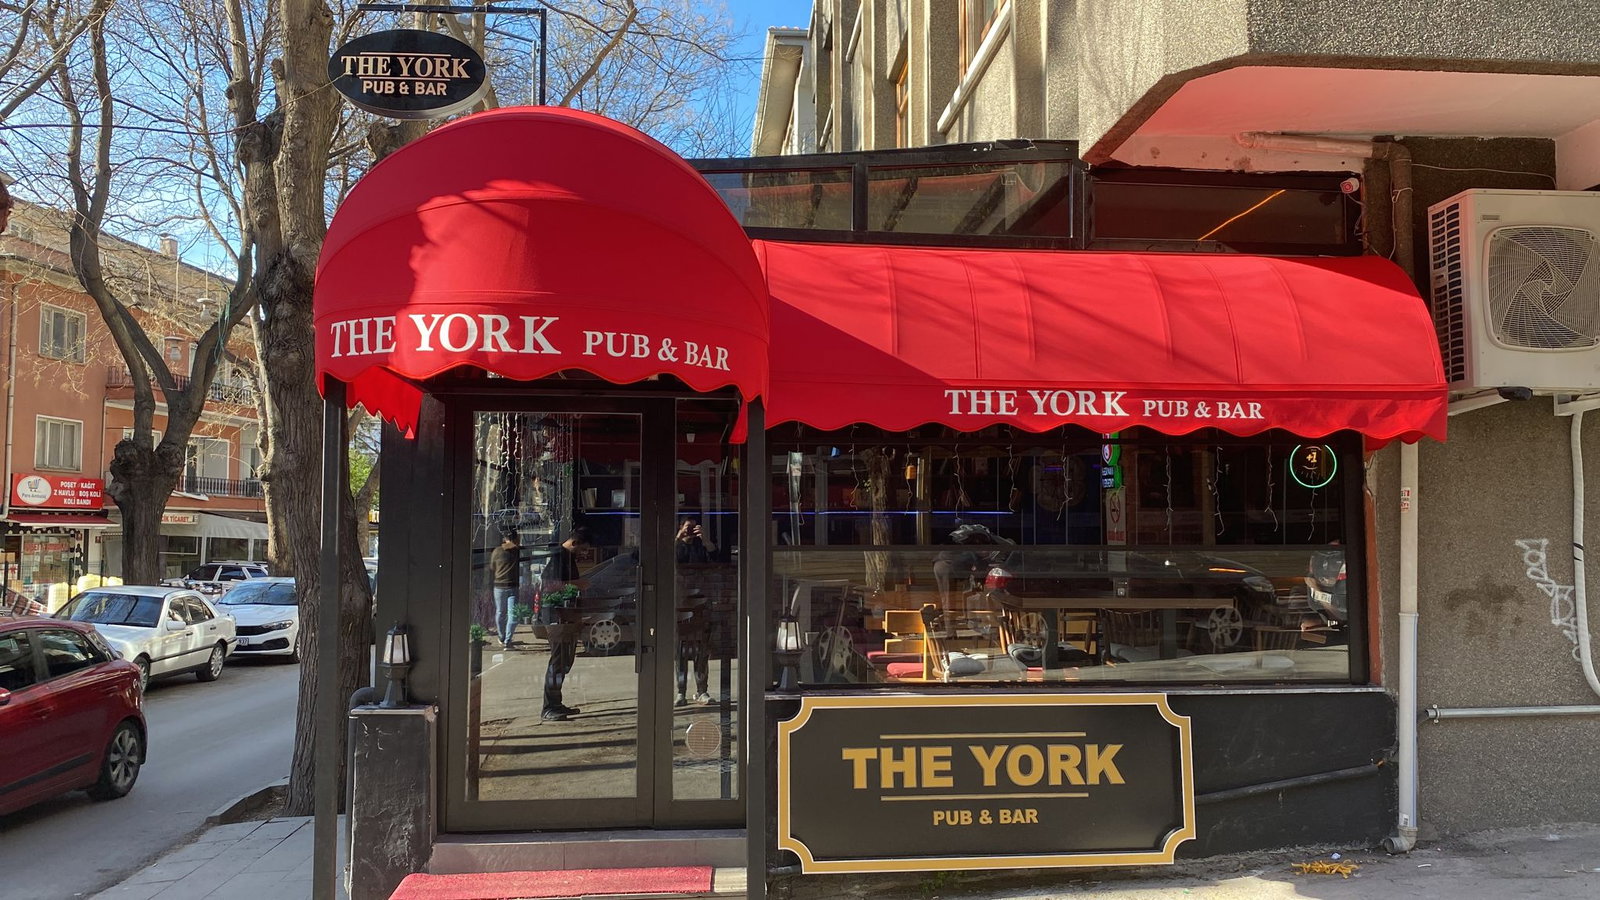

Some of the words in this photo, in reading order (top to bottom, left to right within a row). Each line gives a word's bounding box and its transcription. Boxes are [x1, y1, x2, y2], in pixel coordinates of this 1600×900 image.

[341, 55, 391, 76] THE
[397, 56, 471, 78] YORK
[362, 80, 395, 94] PUB
[399, 81, 410, 95] &
[415, 82, 447, 96] BAR
[331, 315, 396, 358] THE
[409, 313, 561, 356] YORK
[583, 330, 650, 358] PUB
[657, 338, 679, 362] &
[685, 341, 731, 371] BAR
[944, 389, 1018, 416] THE
[1026, 389, 1129, 417] YORK
[1142, 399, 1189, 418] PUB
[1194, 401, 1211, 418] &
[1216, 401, 1265, 419] BAR
[842, 746, 954, 789] THE
[969, 744, 1126, 787] YORK
[933, 809, 973, 826] PUB
[978, 809, 994, 825] &
[999, 808, 1039, 824] BAR
